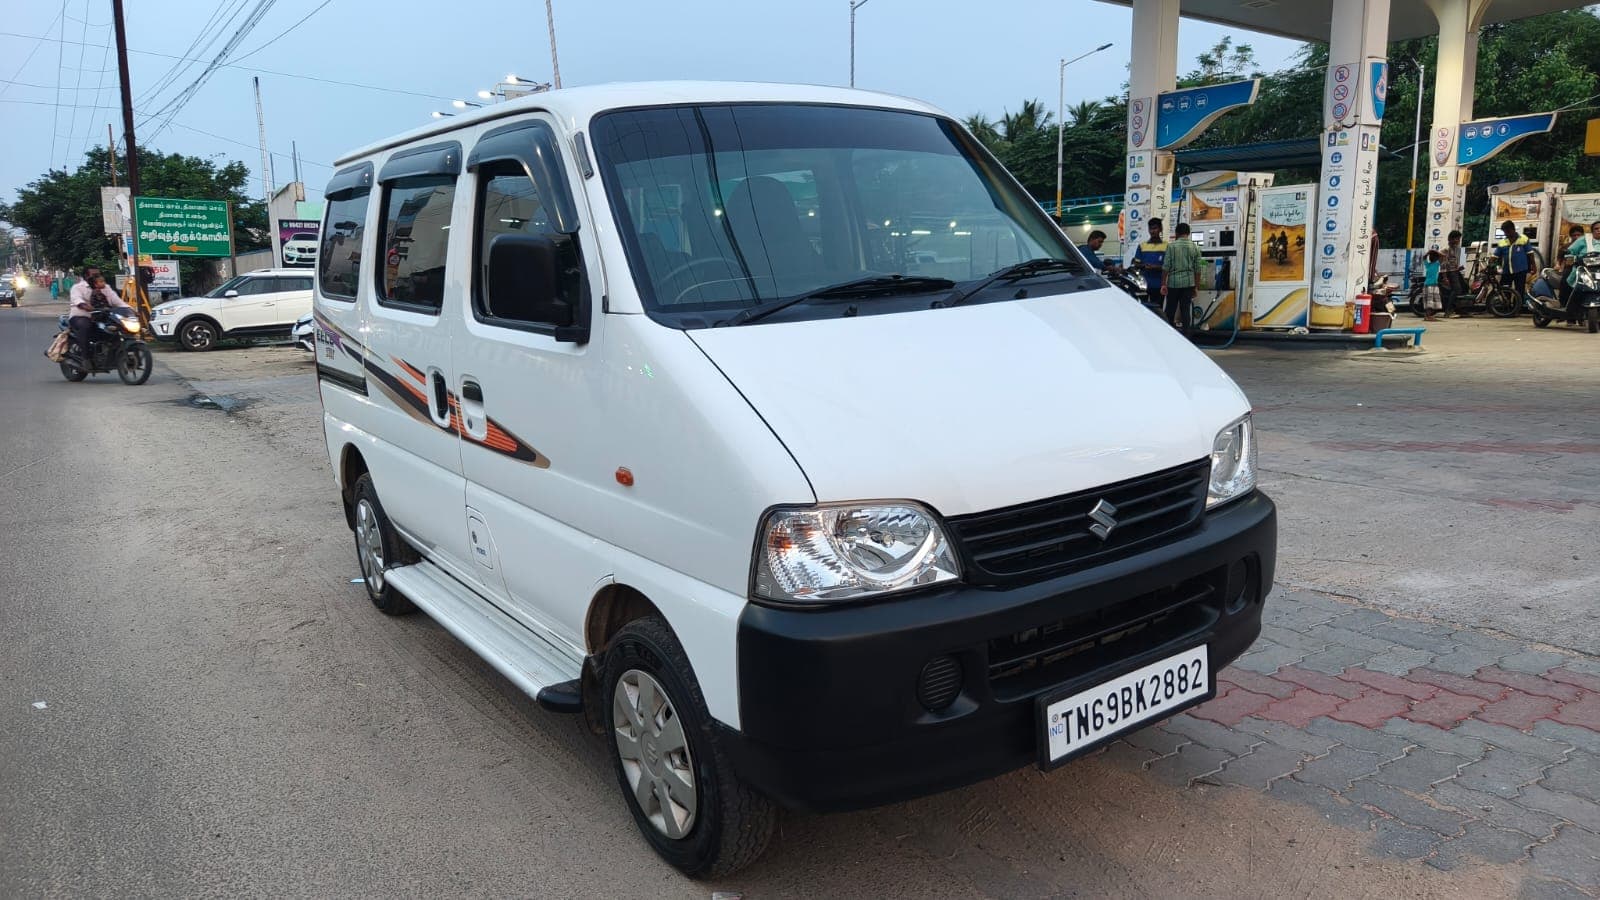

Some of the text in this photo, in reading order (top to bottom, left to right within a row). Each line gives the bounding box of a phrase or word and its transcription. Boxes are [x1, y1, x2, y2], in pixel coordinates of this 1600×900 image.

[1164, 124, 1169, 136] 1
[1466, 147, 1473, 157] 3
[1061, 658, 1203, 745] TN69BK2882
